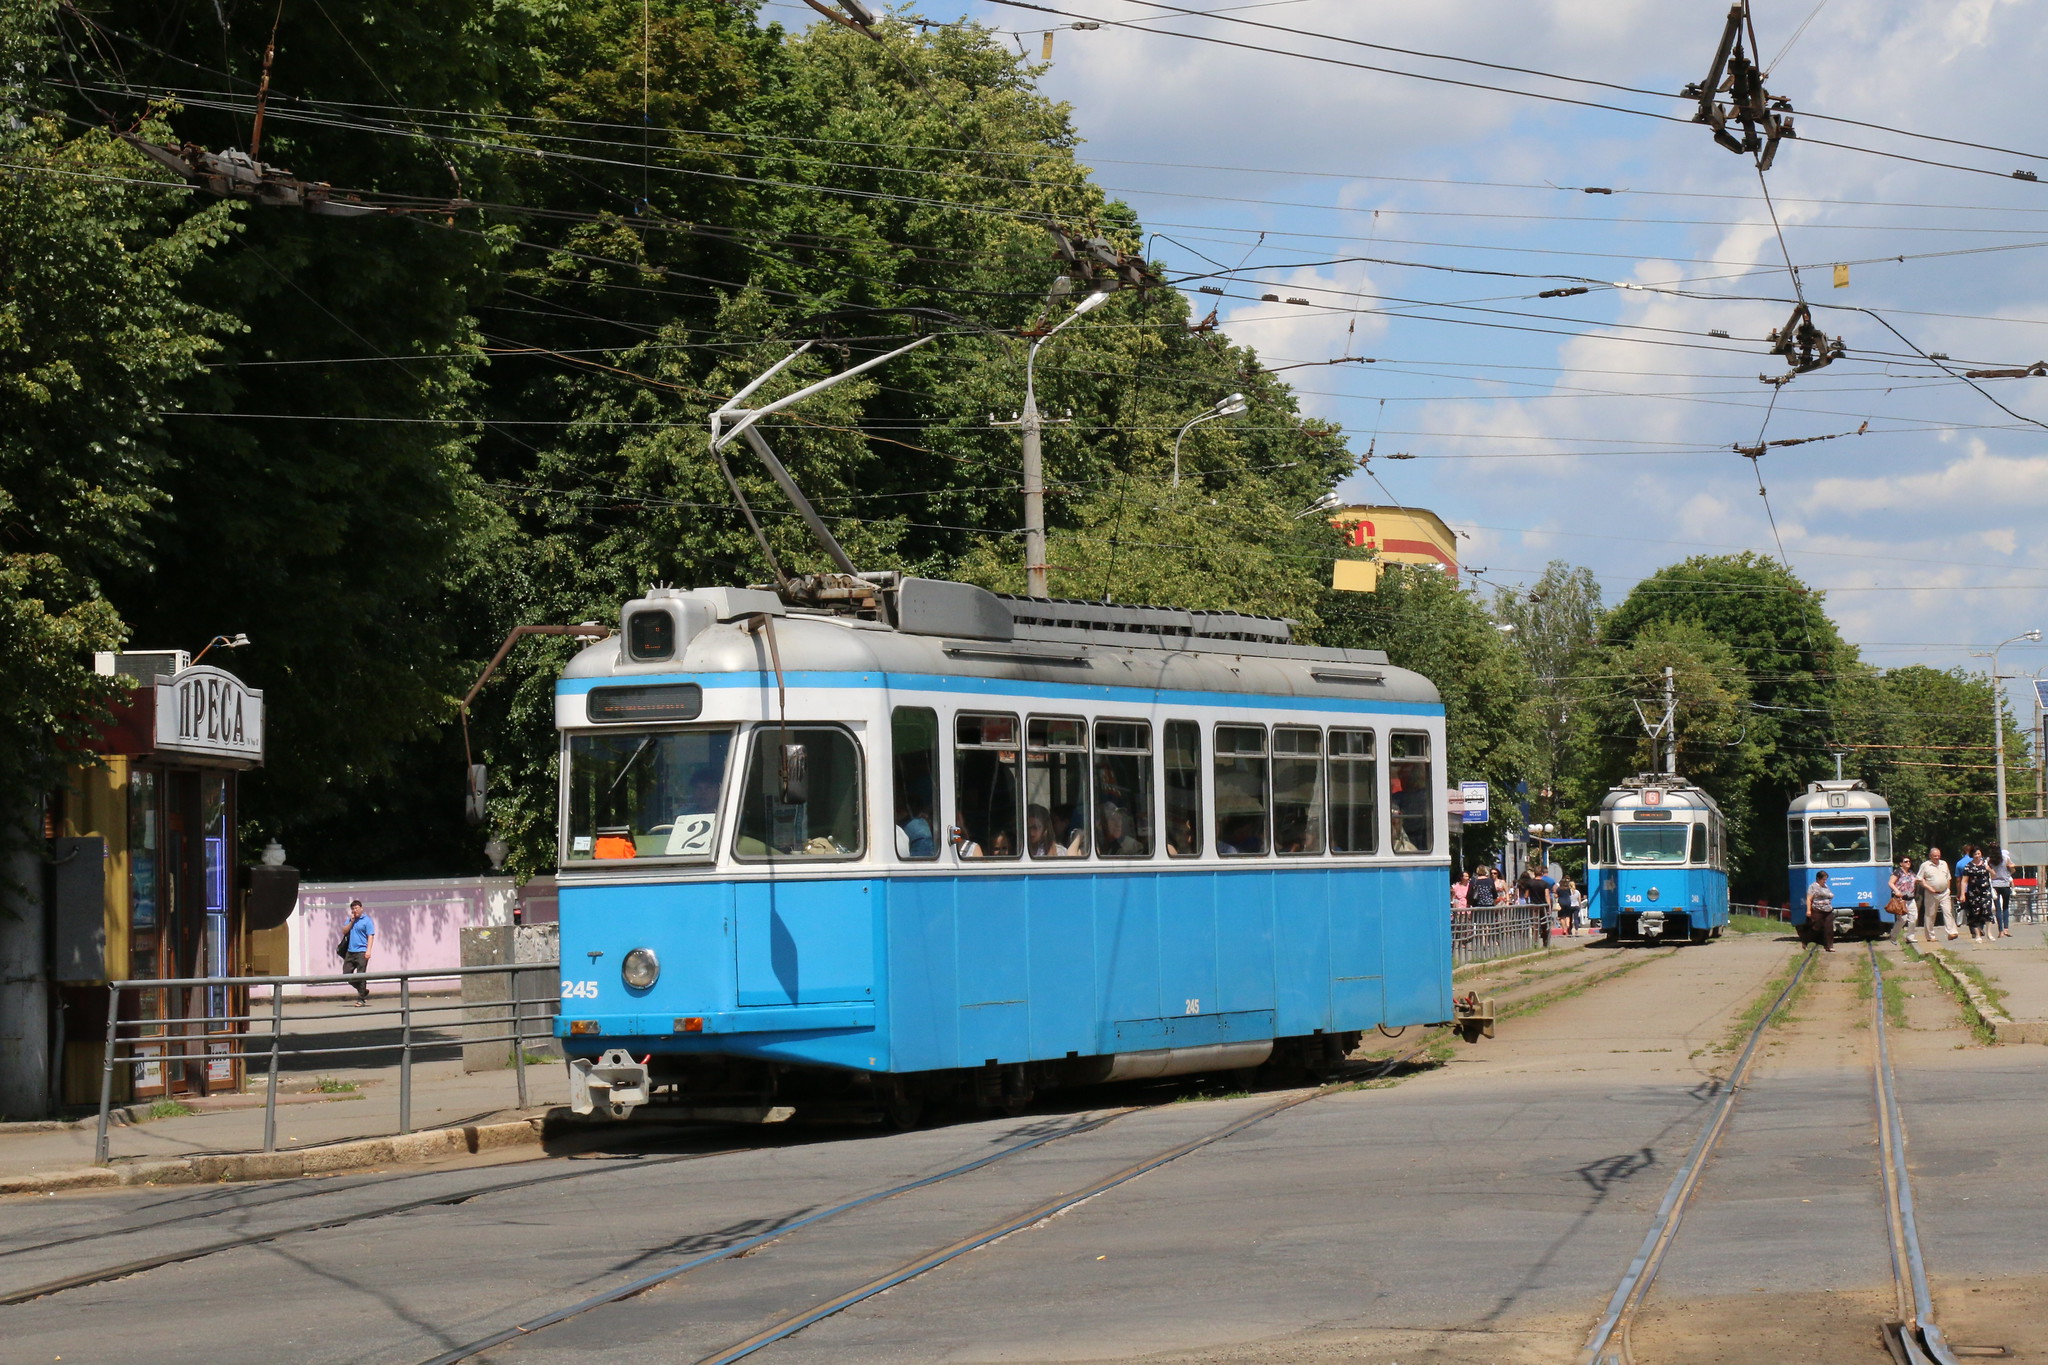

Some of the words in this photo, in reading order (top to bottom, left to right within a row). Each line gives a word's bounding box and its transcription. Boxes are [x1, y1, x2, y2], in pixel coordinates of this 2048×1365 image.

[179, 679, 245, 746] ПРЕСА
[1649, 793, 1657, 802] 6
[681, 820, 711, 850] 2
[1625, 894, 1642, 903] 340
[1857, 891, 1873, 900] 294
[561, 980, 599, 999] 245
[1185, 998, 1200, 1015] 245
